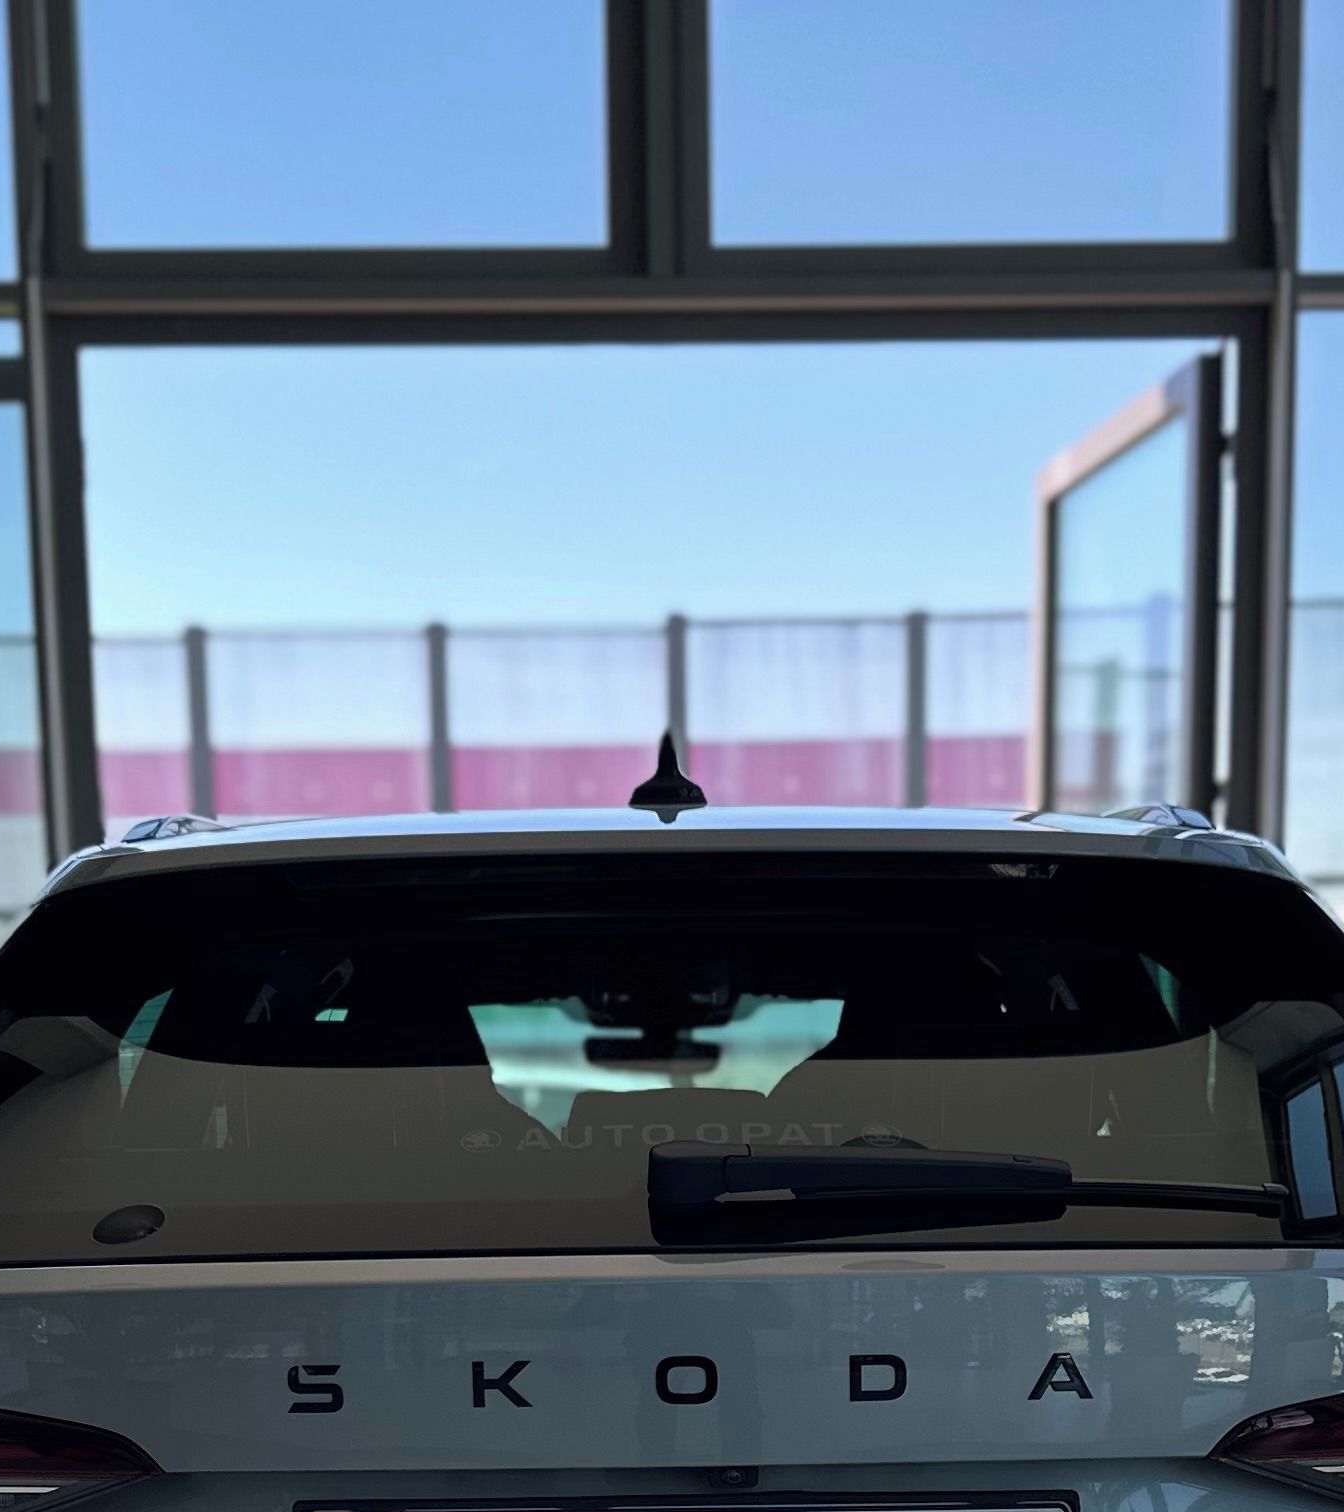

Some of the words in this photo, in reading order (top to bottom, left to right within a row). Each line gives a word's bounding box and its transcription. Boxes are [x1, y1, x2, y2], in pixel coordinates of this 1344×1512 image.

[516, 1123, 676, 1151] AUTO
[696, 1122, 844, 1147] OPAT
[287, 1351, 1094, 1414] SKODA
